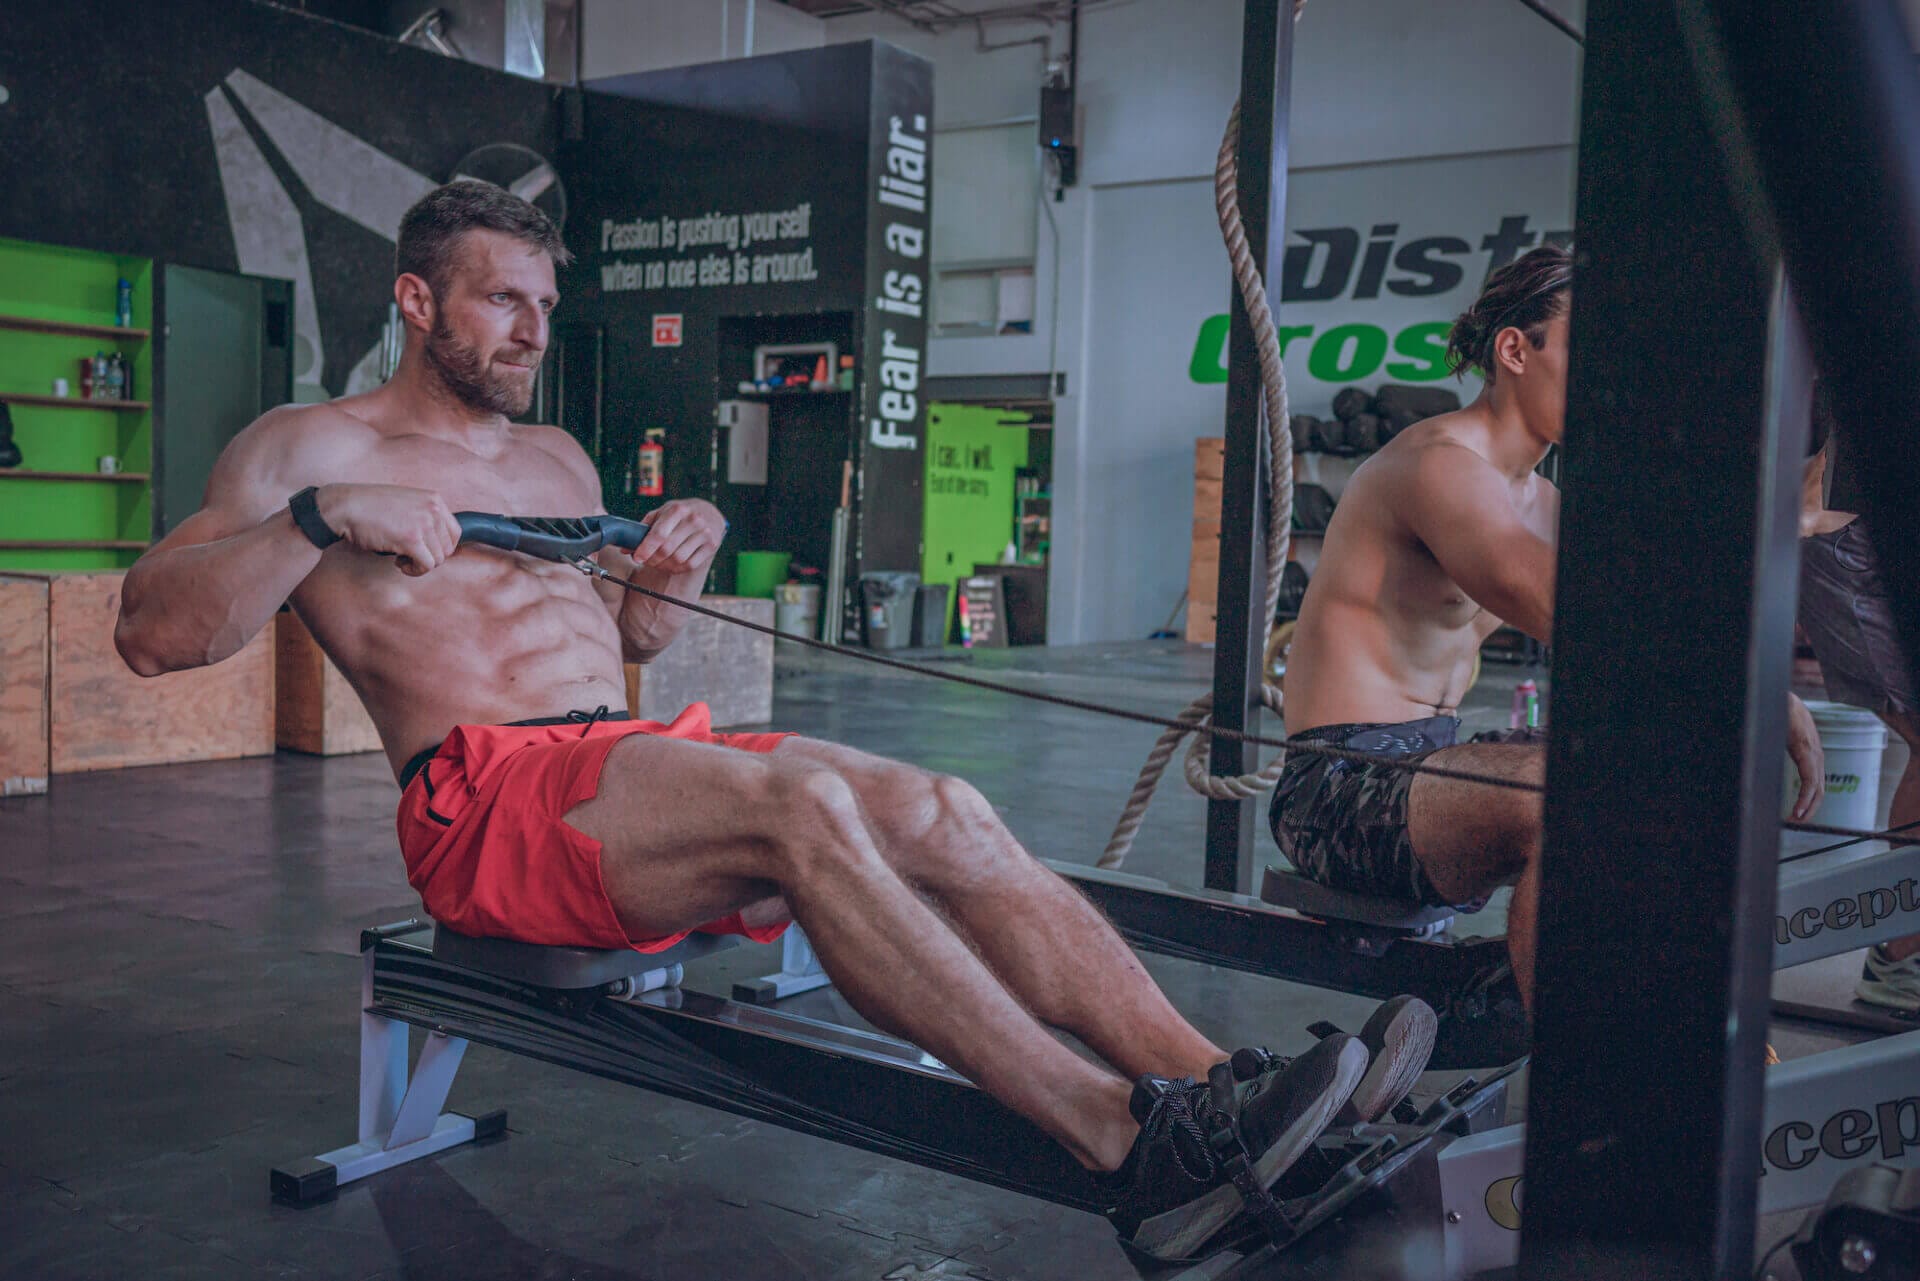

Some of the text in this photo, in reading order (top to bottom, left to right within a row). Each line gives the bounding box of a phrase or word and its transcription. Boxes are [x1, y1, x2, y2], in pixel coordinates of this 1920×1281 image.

[601, 202, 811, 253] Passion is pushing yourself
[601, 246, 818, 291] when no one else is around.
[869, 114, 927, 451] Fear is a liar.
[1189, 313, 1486, 384] Cros
[1760, 1095, 1920, 1176] cep
